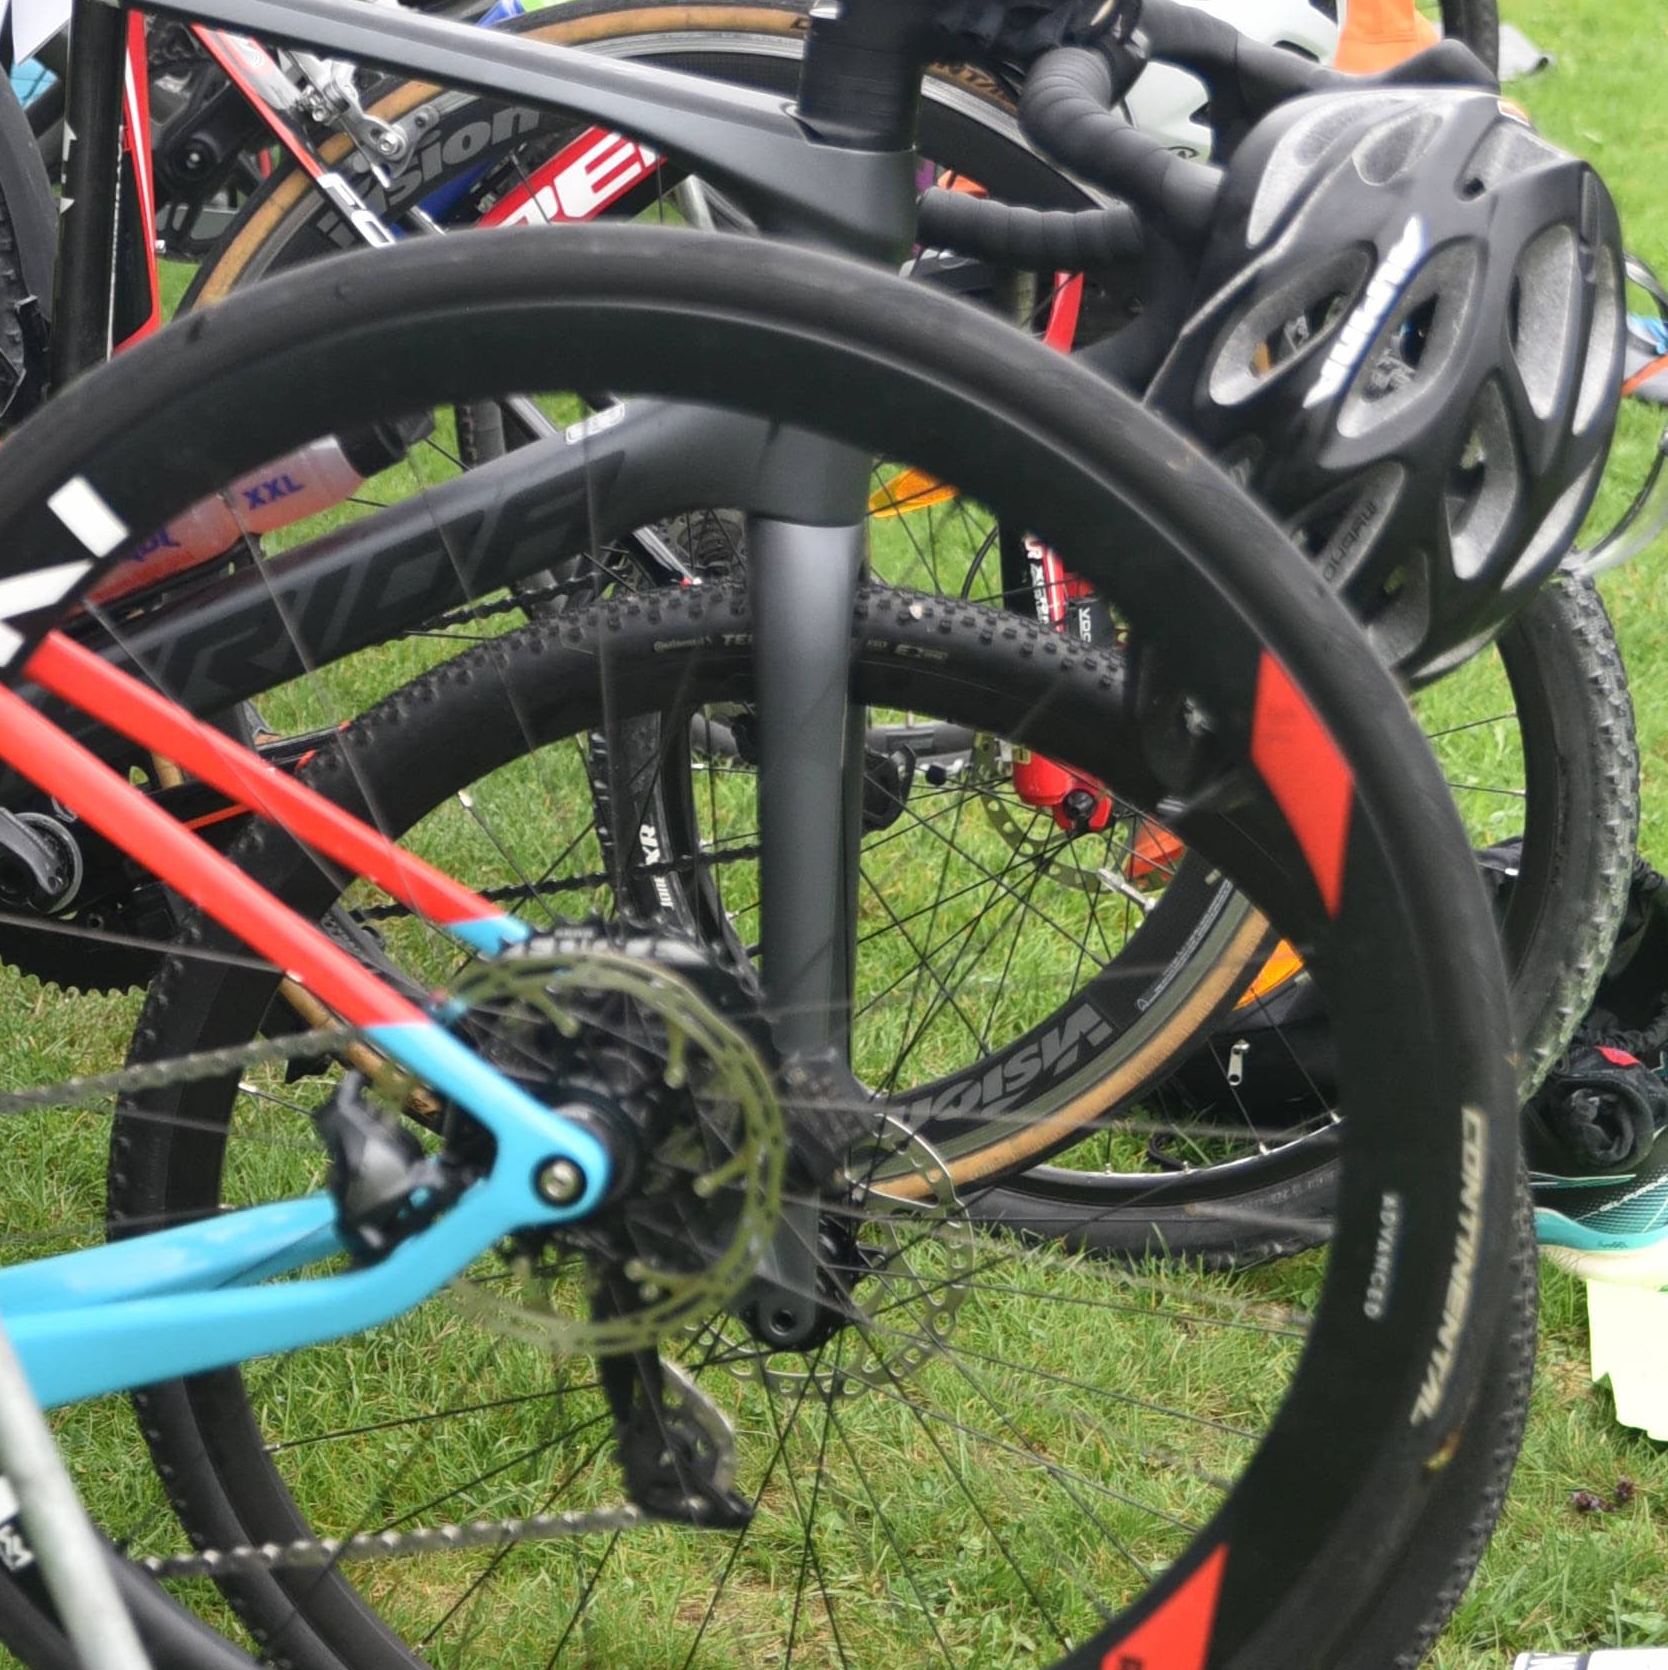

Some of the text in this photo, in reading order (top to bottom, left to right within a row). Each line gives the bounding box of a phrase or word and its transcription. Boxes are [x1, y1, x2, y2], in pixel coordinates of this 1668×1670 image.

[242, 472, 305, 512] XXL
[1362, 1192, 1400, 1320] ADVANCED
[1409, 1105, 1488, 1427] CONTINENTAL
